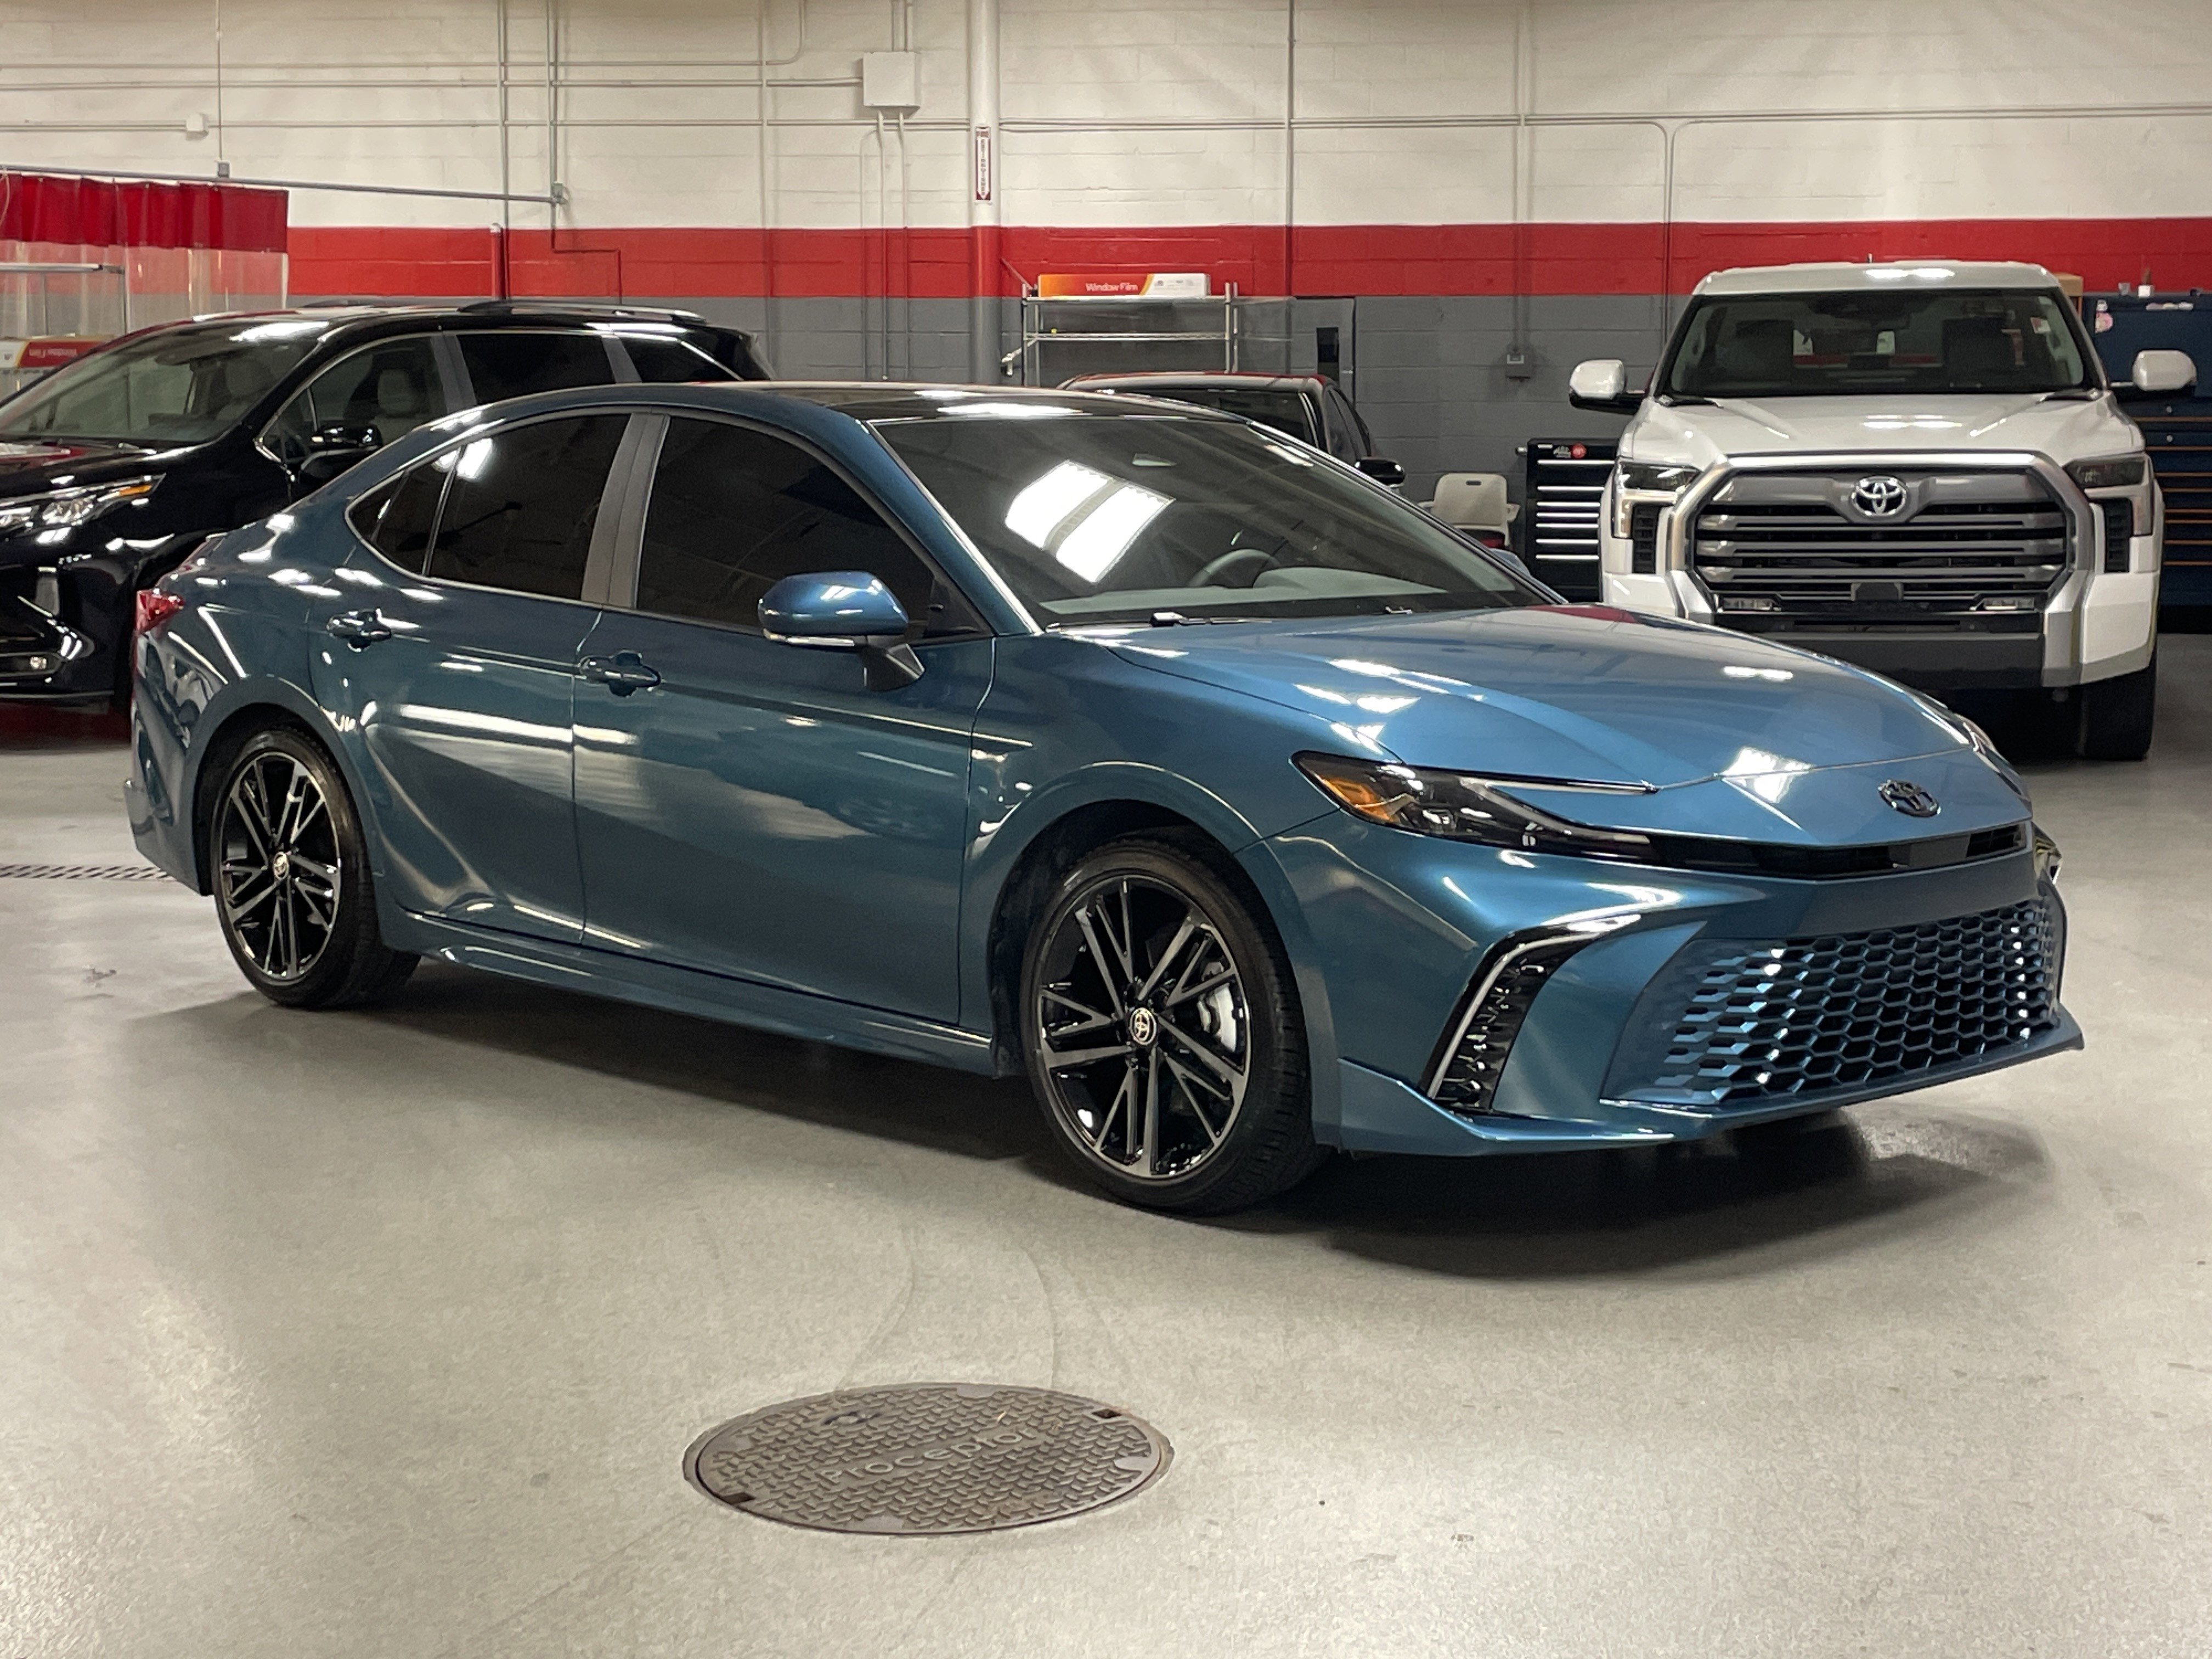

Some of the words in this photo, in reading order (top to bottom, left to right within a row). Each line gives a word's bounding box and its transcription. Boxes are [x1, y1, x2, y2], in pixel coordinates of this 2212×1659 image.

[1086, 282, 1119, 292] Window
[1120, 282, 1138, 291] Film
[816, 1427, 1037, 1483] Proceptor
